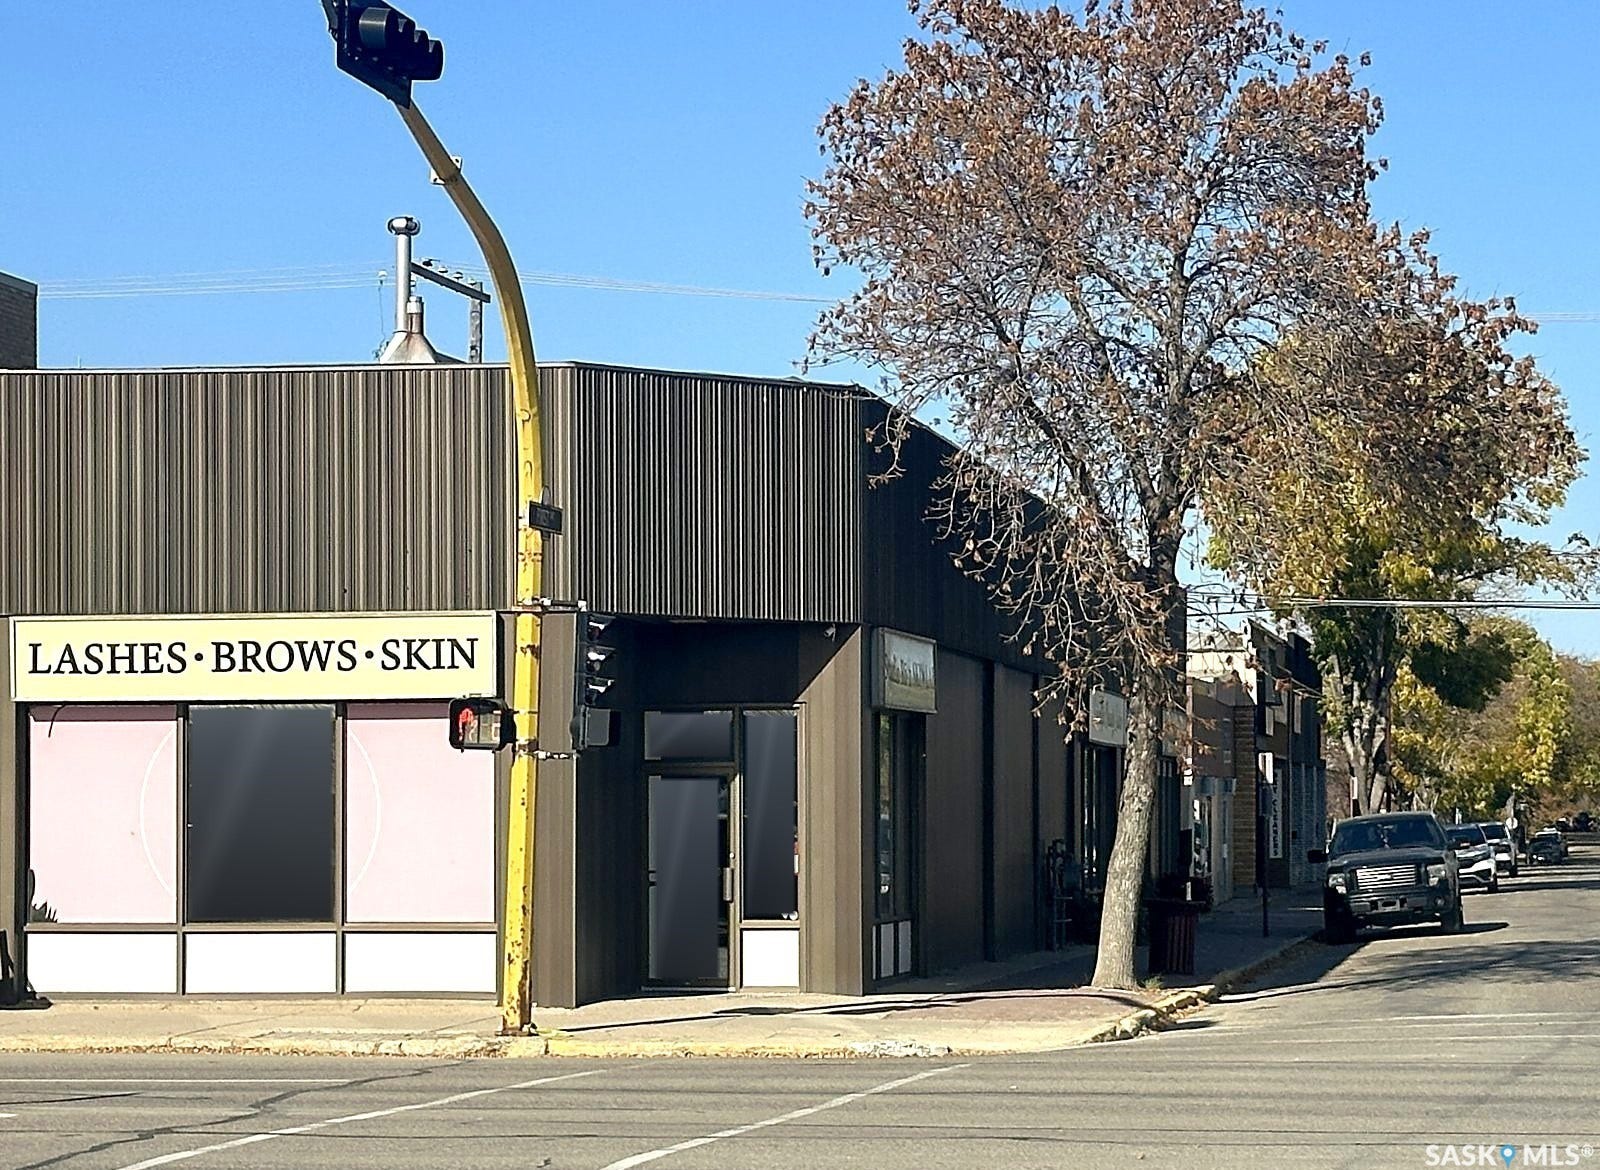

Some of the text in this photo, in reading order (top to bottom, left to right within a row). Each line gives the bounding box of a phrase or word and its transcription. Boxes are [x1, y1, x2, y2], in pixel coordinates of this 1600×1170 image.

[28, 638, 479, 675] LASHES BROWS SKIN
